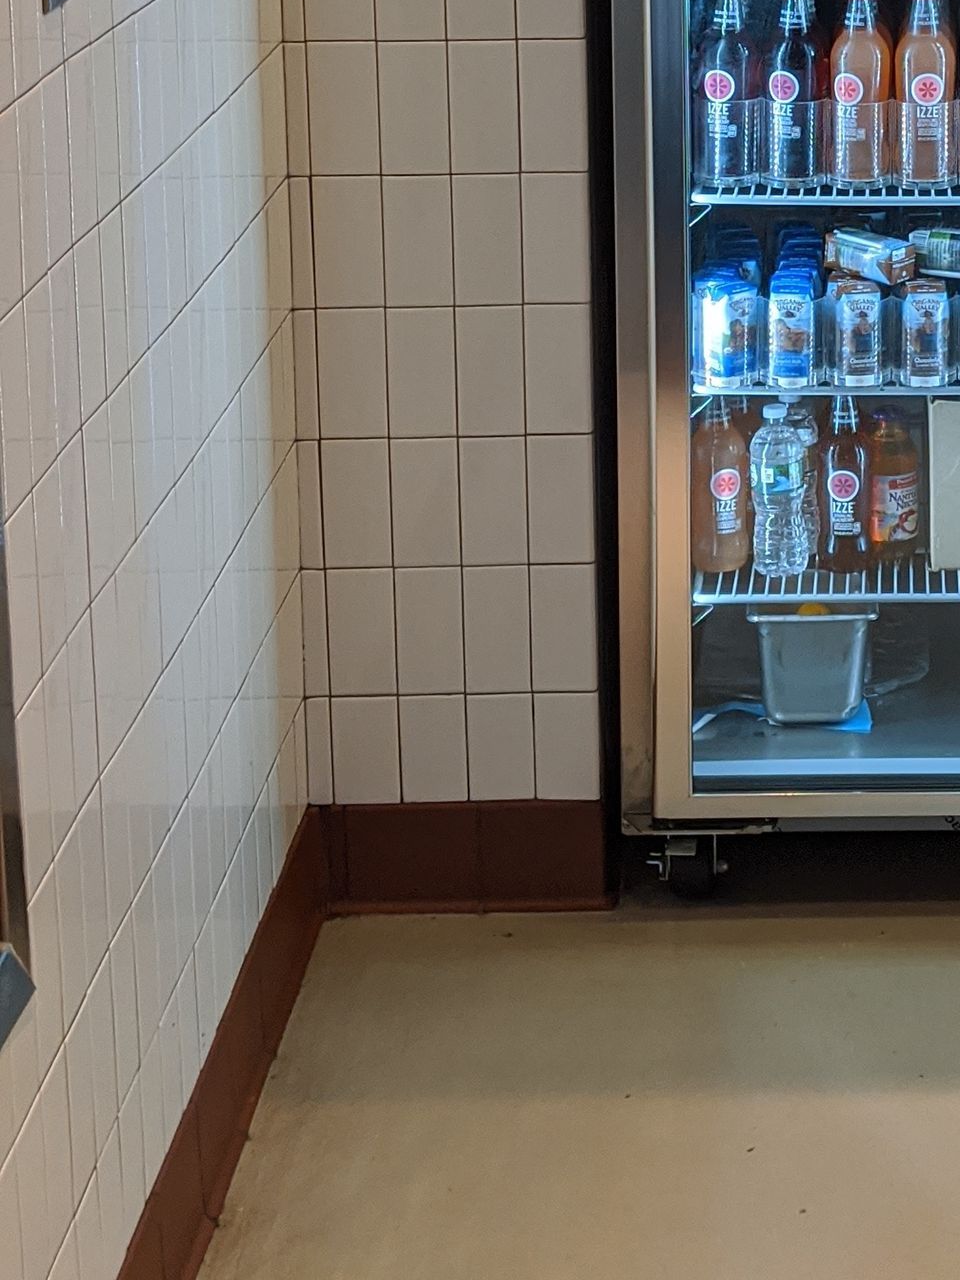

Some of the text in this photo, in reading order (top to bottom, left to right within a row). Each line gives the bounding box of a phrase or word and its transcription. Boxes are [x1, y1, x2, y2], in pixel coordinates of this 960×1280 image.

[916, 106, 940, 118] IZZE
[716, 499, 737, 513] IZZE
[832, 501, 855, 514] IZZE
